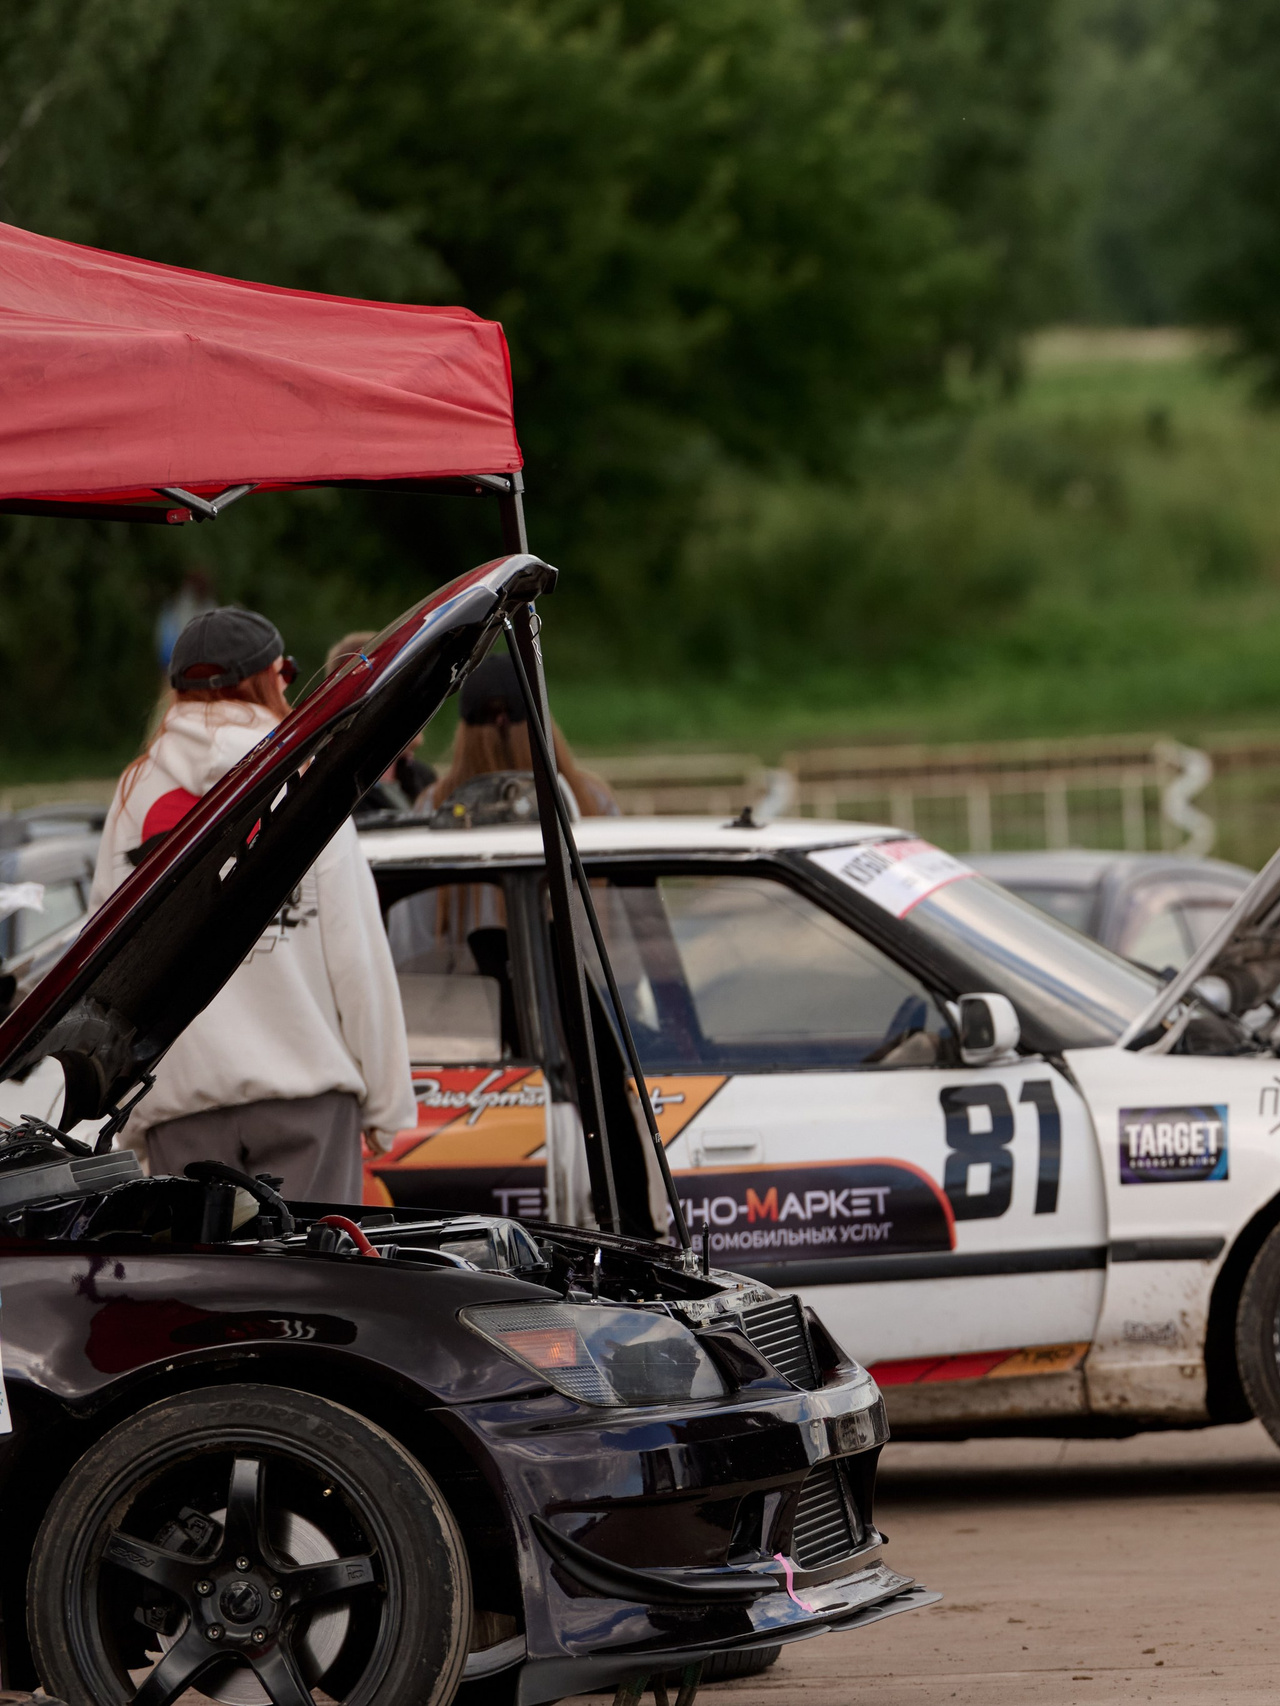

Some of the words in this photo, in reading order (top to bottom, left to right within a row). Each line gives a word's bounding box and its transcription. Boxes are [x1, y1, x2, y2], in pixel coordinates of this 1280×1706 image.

[1258, 1087, 1280, 1117] П
[938, 1079, 1062, 1221] 81
[1124, 1120, 1222, 1158] TARGET
[681, 1225, 836, 1252] ВОМОБИЛЬНЫХ
[840, 1221, 893, 1243] УСЛУГ
